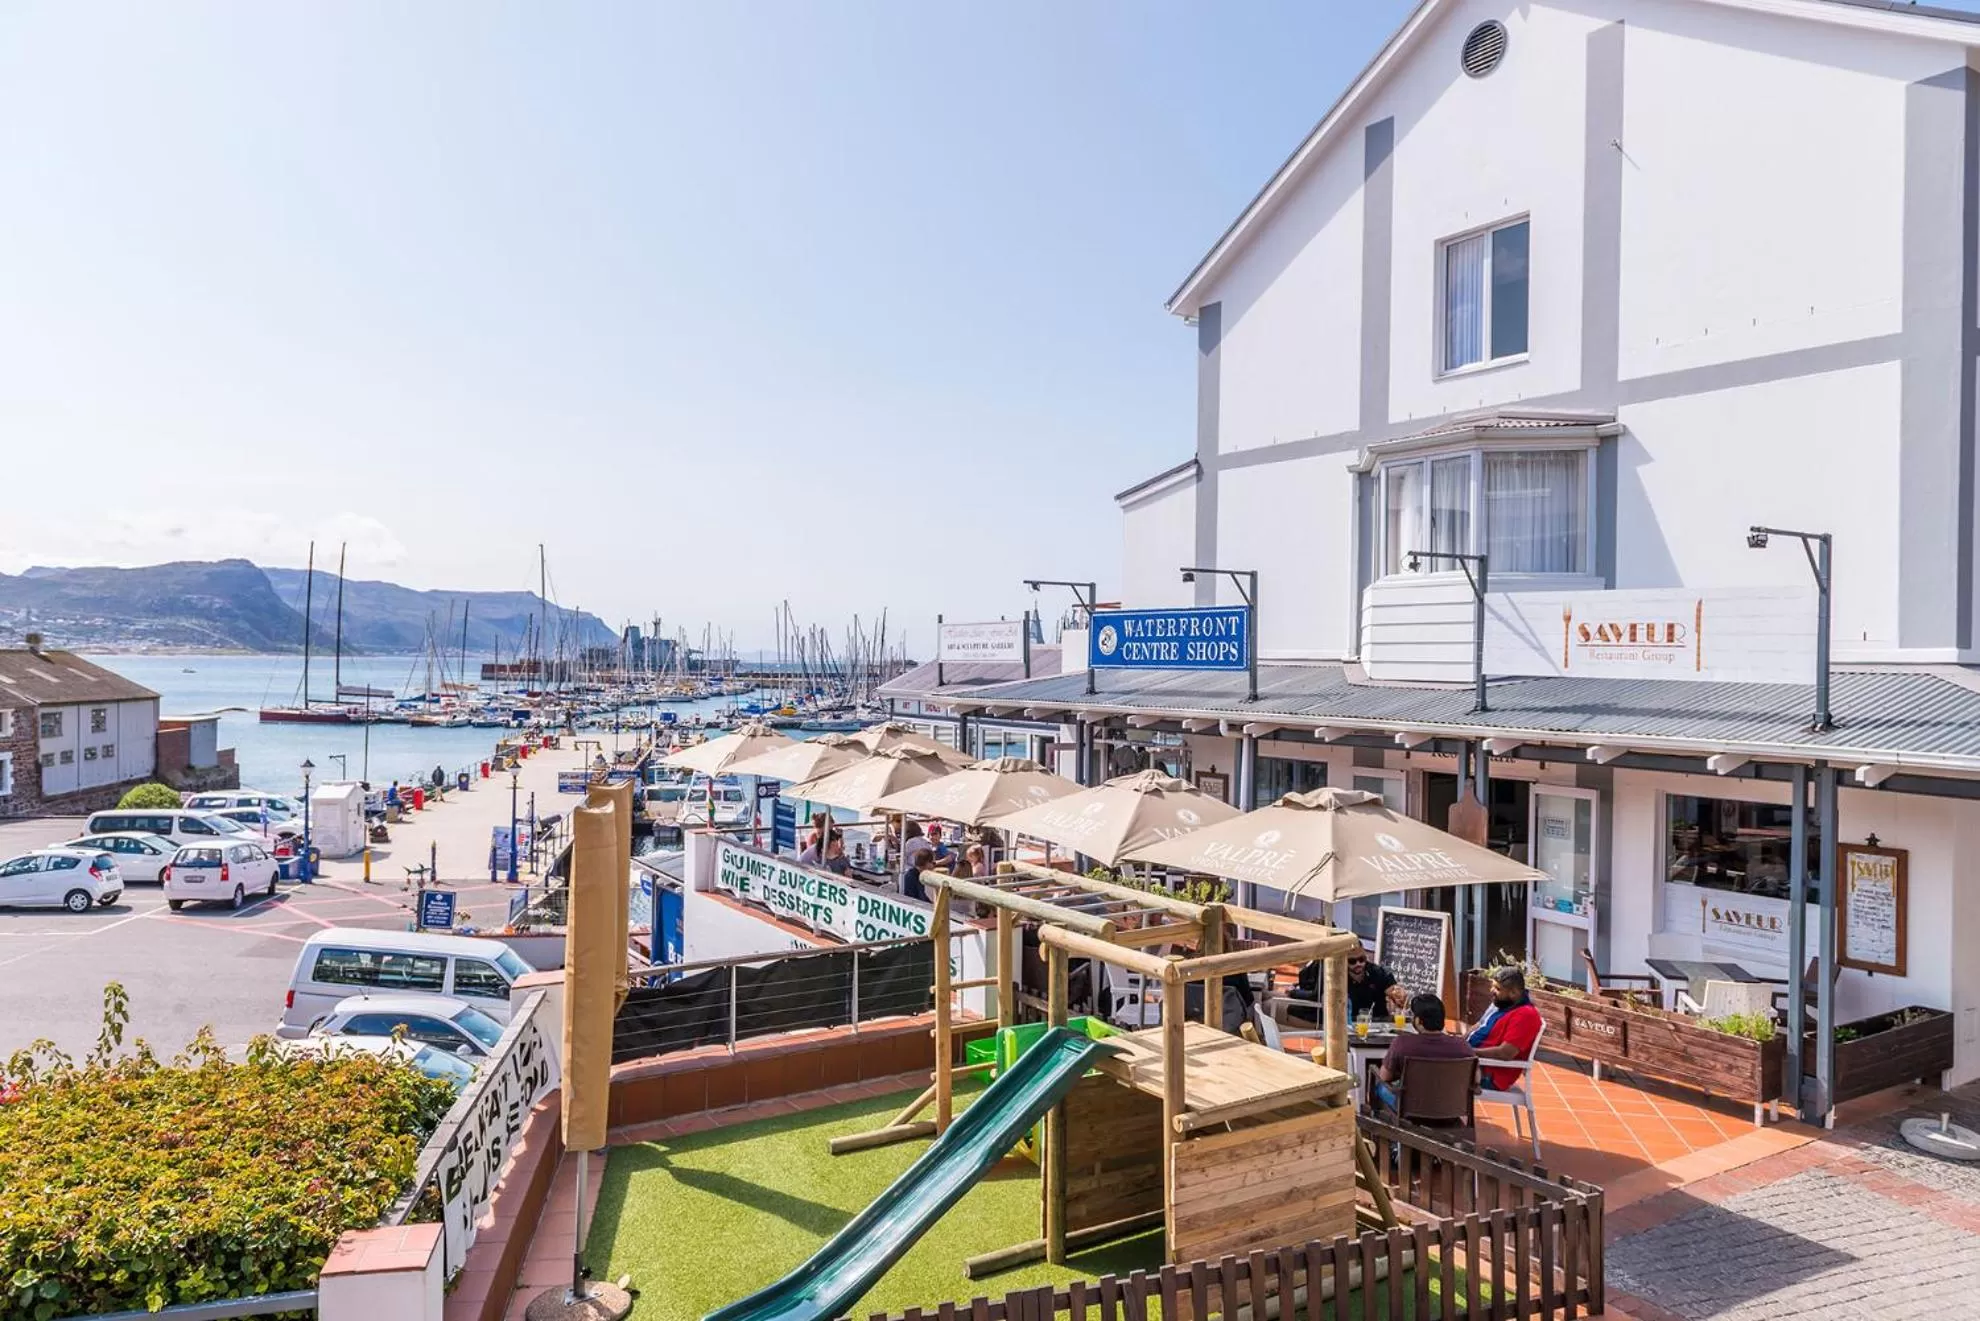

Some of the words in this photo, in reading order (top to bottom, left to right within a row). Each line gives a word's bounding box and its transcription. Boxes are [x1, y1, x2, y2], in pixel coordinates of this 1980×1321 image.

[1123, 616, 1240, 638] WATERFRONT
[1577, 622, 1687, 643] SAVEUR
[1122, 642, 1180, 661] CENTRE
[1186, 641, 1239, 662] SHOPS
[1589, 650, 1639, 662] Restaurant
[1641, 649, 1676, 665] Group
[722, 848, 776, 882] GUMET
[779, 869, 848, 907] BURGERS
[857, 895, 926, 935] DRINKS
[763, 885, 833, 925] DESSERTS
